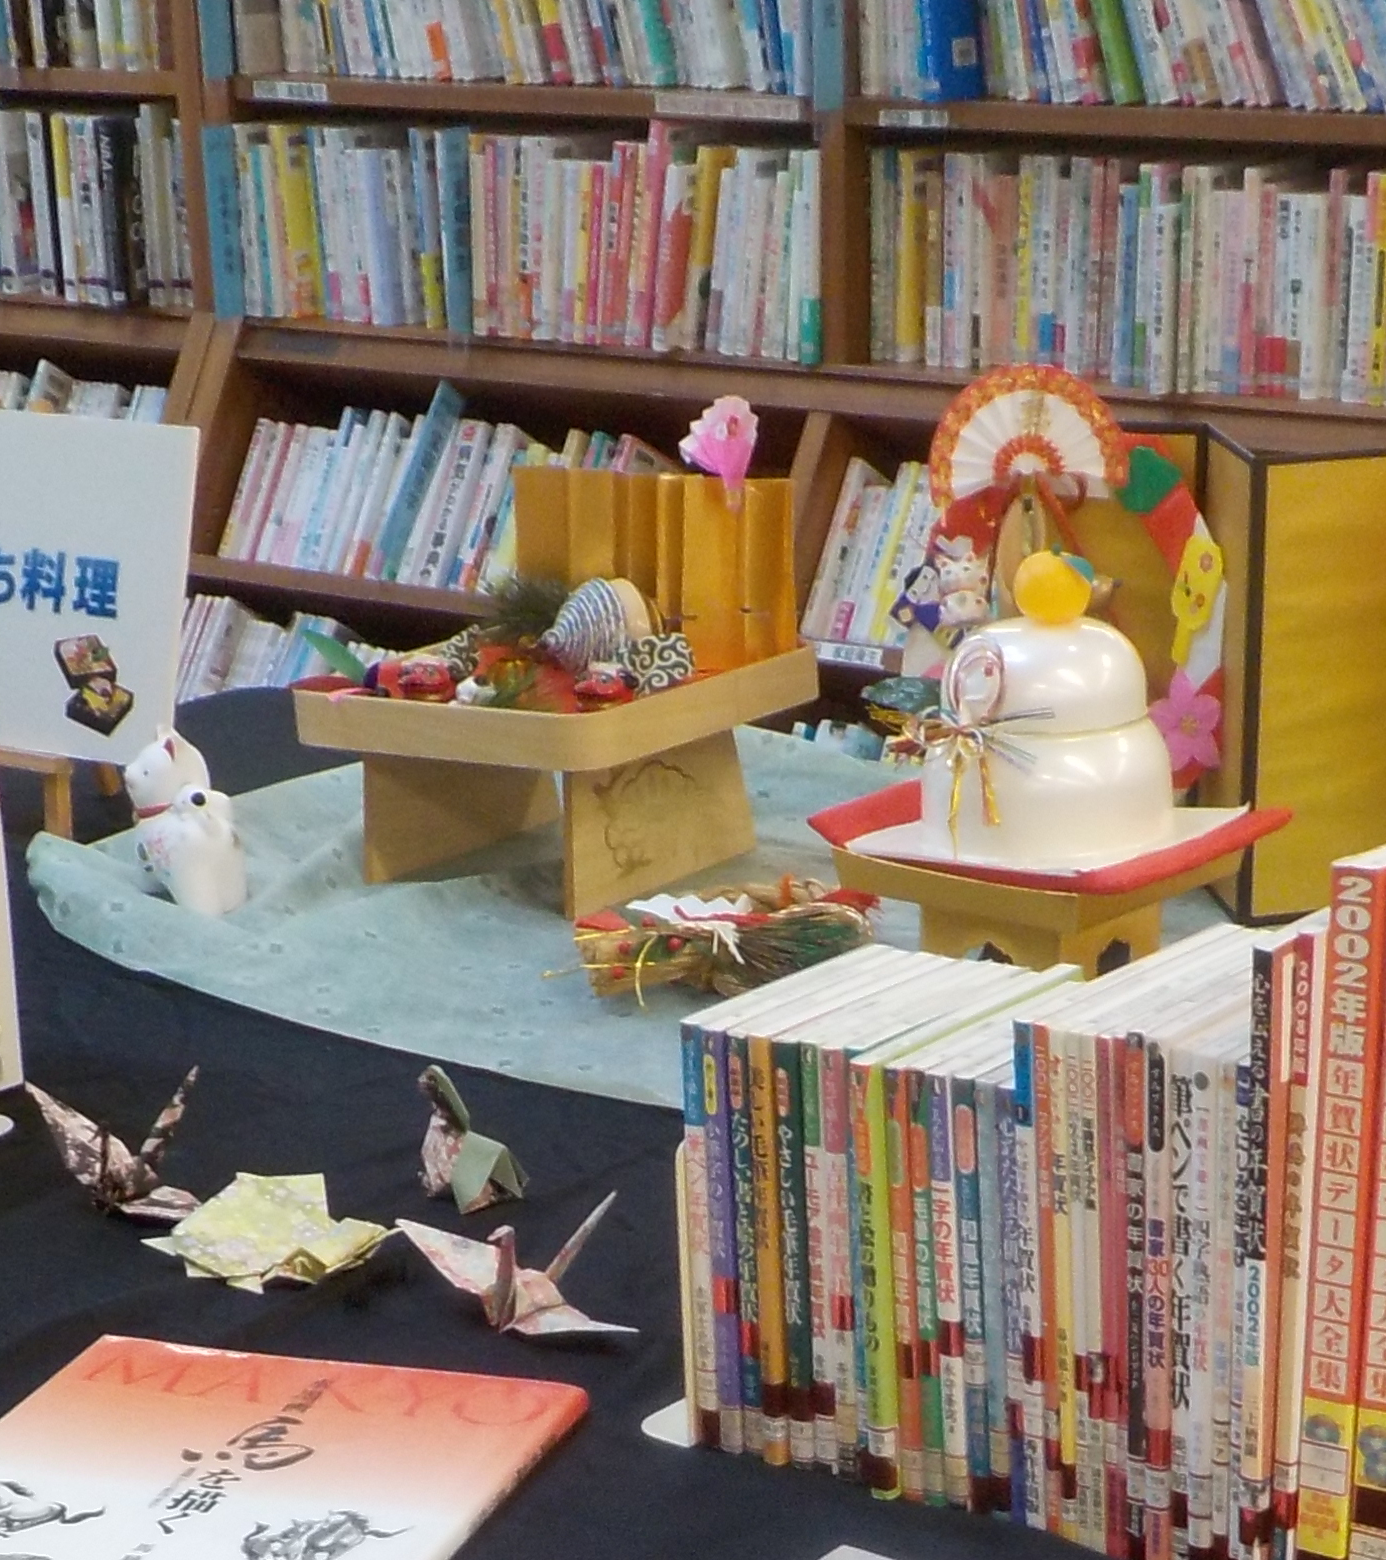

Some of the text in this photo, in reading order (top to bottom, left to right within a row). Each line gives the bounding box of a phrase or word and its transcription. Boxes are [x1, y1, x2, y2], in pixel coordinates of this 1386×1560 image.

[931, 1186, 957, 1305] 一字の年賀状
[1168, 1072, 1192, 1411] 筆ペンで書く年賀状
[1312, 872, 1374, 1394] 2002年版 年賀状データ大全集
